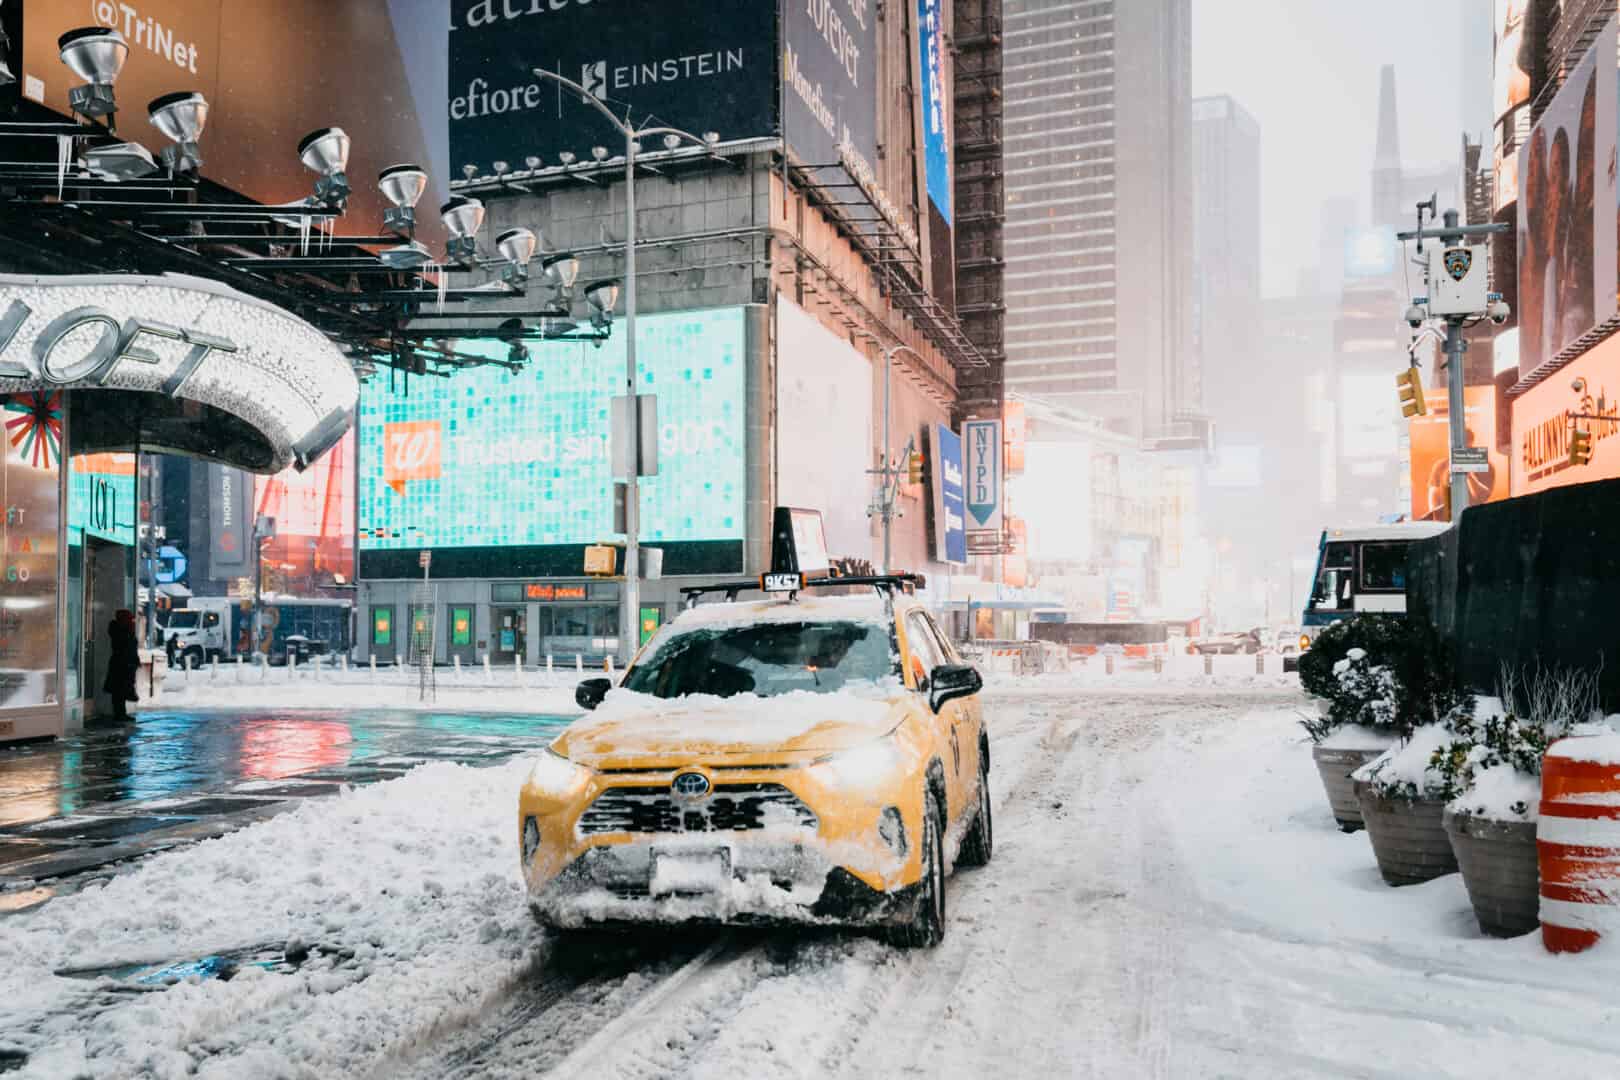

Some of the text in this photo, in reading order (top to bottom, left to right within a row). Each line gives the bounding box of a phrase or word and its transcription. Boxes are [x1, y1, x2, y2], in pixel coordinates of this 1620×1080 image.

[92, 0, 198, 74] @TriNet
[806, 0, 860, 88] orever
[448, 48, 744, 121] efiore EINSTEIN
[222, 473, 232, 527] THOMSON
[976, 427, 987, 503] NYPD
